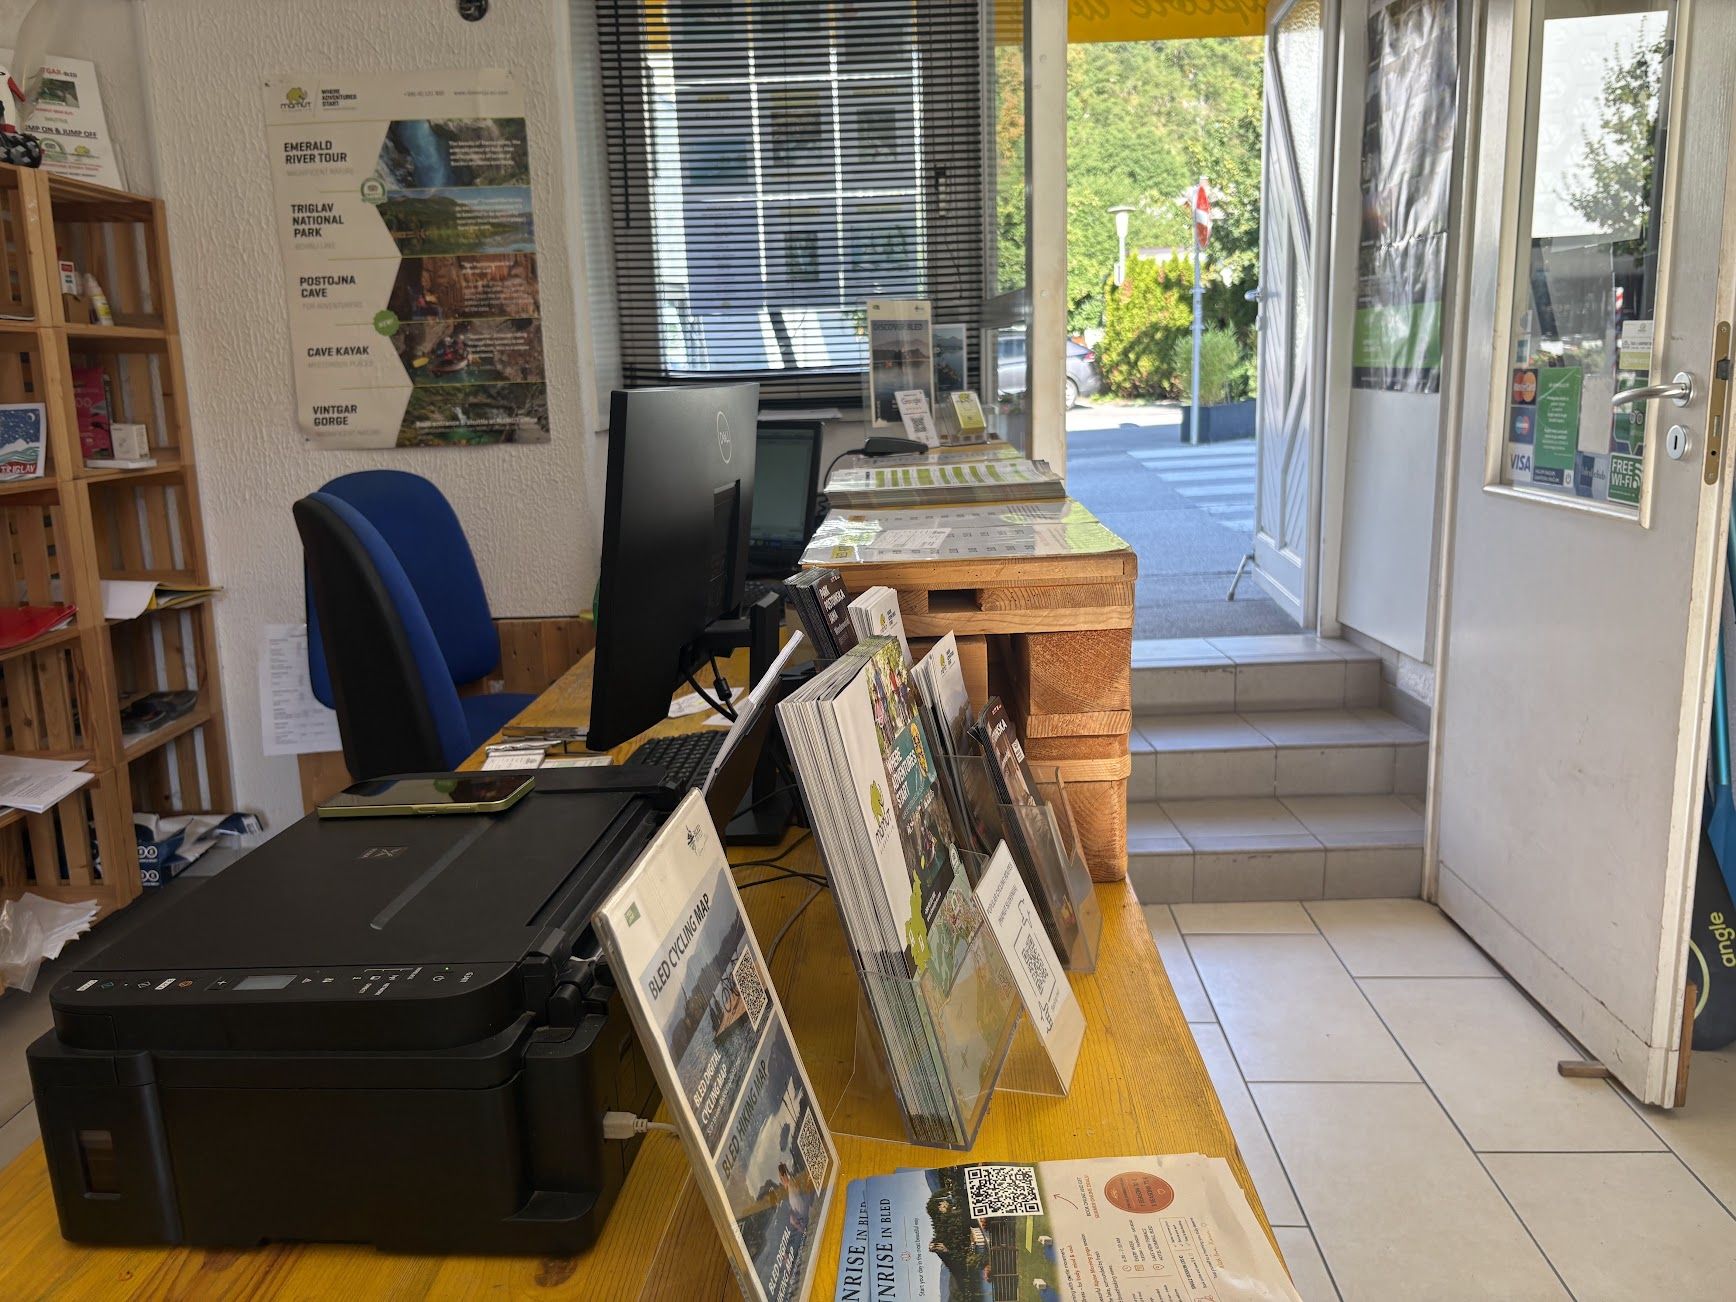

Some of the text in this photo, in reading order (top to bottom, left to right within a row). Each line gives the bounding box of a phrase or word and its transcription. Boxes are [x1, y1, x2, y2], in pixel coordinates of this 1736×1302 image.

[284, 141, 332, 152] EMERALD
[285, 152, 347, 165] RIVER TOUR
[291, 204, 334, 214] TRIGLAV
[292, 215, 344, 226] NATIONAL
[294, 228, 322, 238] PARK
[300, 275, 356, 287] POSTOJNA
[301, 288, 328, 298] CAVE
[307, 346, 370, 358] CAVE KAYAK
[313, 405, 357, 415] VINTGAR
[314, 417, 349, 427] GORGE
[1, 464, 36, 474] TRIGLAV
[1510, 453, 1531, 473] VISA
[1612, 459, 1633, 474] FREE
[1611, 473, 1633, 488] WI-FI
[875, 808, 892, 845] mamut
[1708, 911, 1736, 968] angle
[648, 892, 711, 1001] BLED CYCLING MAP
[693, 1049, 722, 1108] BLED DIGITAL
[701, 1082, 721, 1125] CYCLING
[715, 1063, 728, 1090] MAP
[722, 1135, 740, 1178] BLED
[738, 1094, 757, 1141] HIKING
[753, 1059, 770, 1094] MAP
[1080, 1192, 1088, 1205] ONLINE
[880, 1198, 892, 1223] BLED
[856, 1229, 868, 1241] IN
[881, 1227, 893, 1239] IN
[768, 1226, 791, 1296] BLED DIGITAL
[1086, 1256, 1095, 1273] Morning
